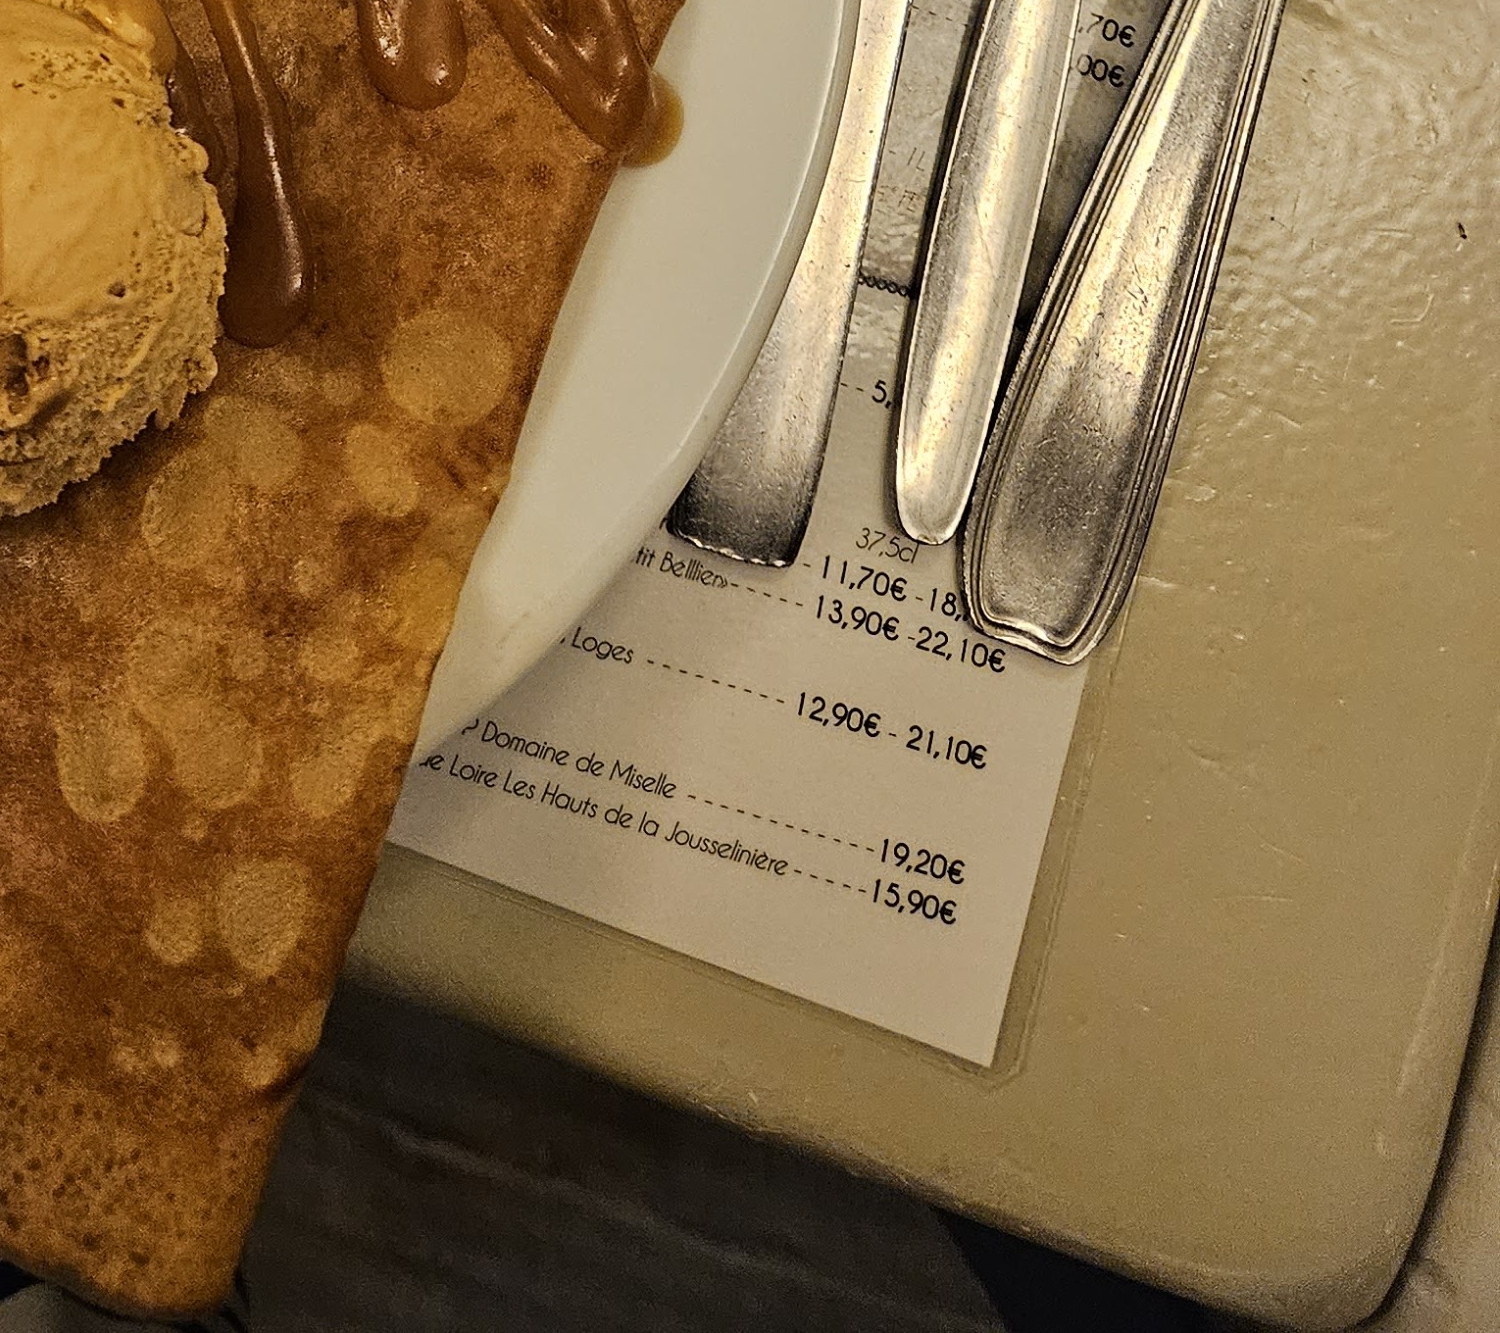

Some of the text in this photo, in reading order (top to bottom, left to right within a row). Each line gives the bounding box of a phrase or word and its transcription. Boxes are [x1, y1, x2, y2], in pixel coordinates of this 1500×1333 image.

[822, 555, 906, 601] 11,70€
[855, 527, 920, 563] 37,5cl
[817, 595, 898, 640] 13,90€
[571, 626, 986, 769] Loges 12,90€ 21,10€
[448, 754, 956, 924] Loire Les Hauts de la Jousselinière 15,90€
[481, 720, 964, 884] Domaine de Miselle 19,20€
